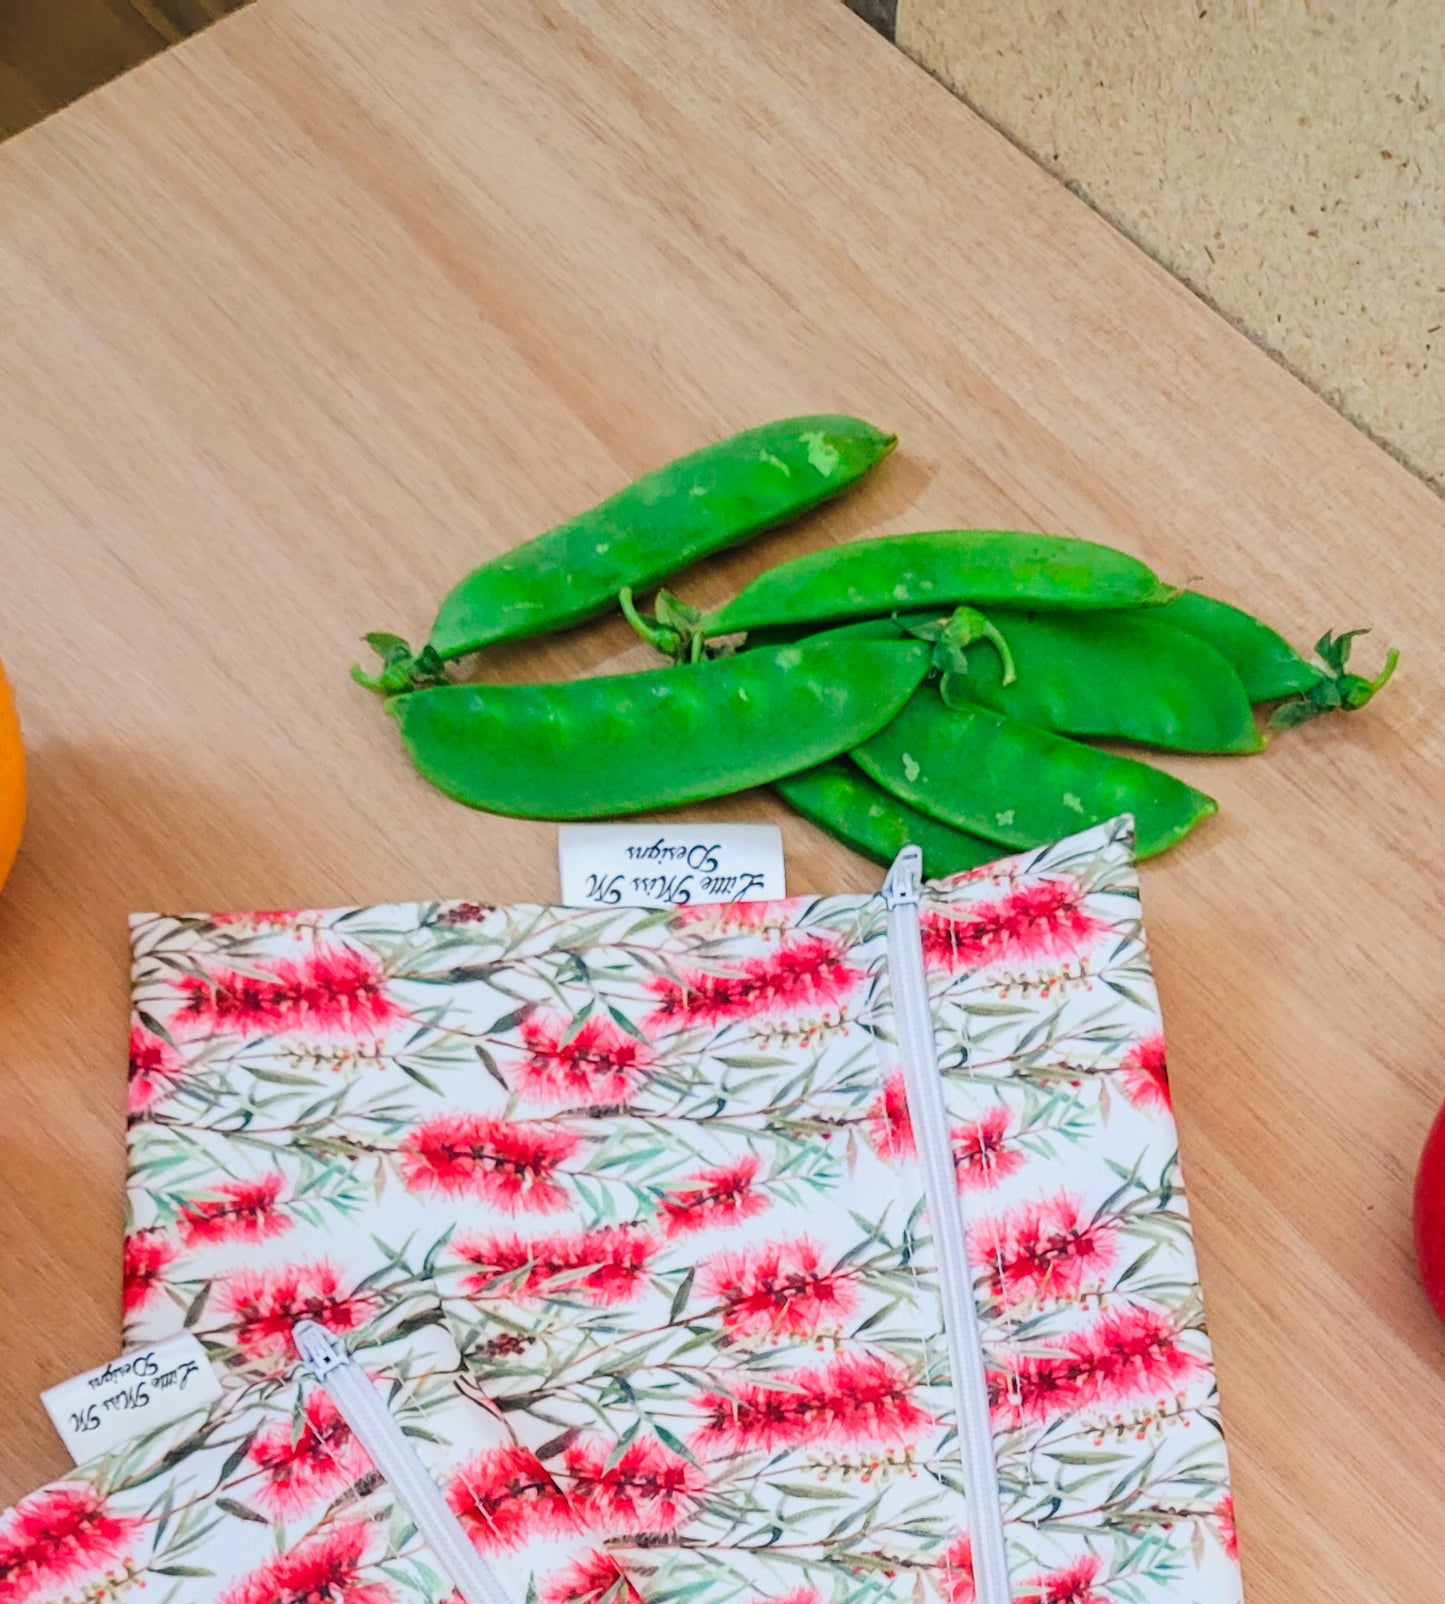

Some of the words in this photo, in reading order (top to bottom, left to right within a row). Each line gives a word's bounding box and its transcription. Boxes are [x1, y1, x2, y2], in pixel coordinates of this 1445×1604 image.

[626, 838, 722, 873] Designs
[585, 873, 625, 904] M
[632, 874, 694, 904] Miss
[700, 872, 765, 903] Little
[88, 1352, 159, 1390] Designs
[151, 1360, 199, 1390] Little
[102, 1381, 150, 1410] Miss
[69, 1404, 101, 1432] M
